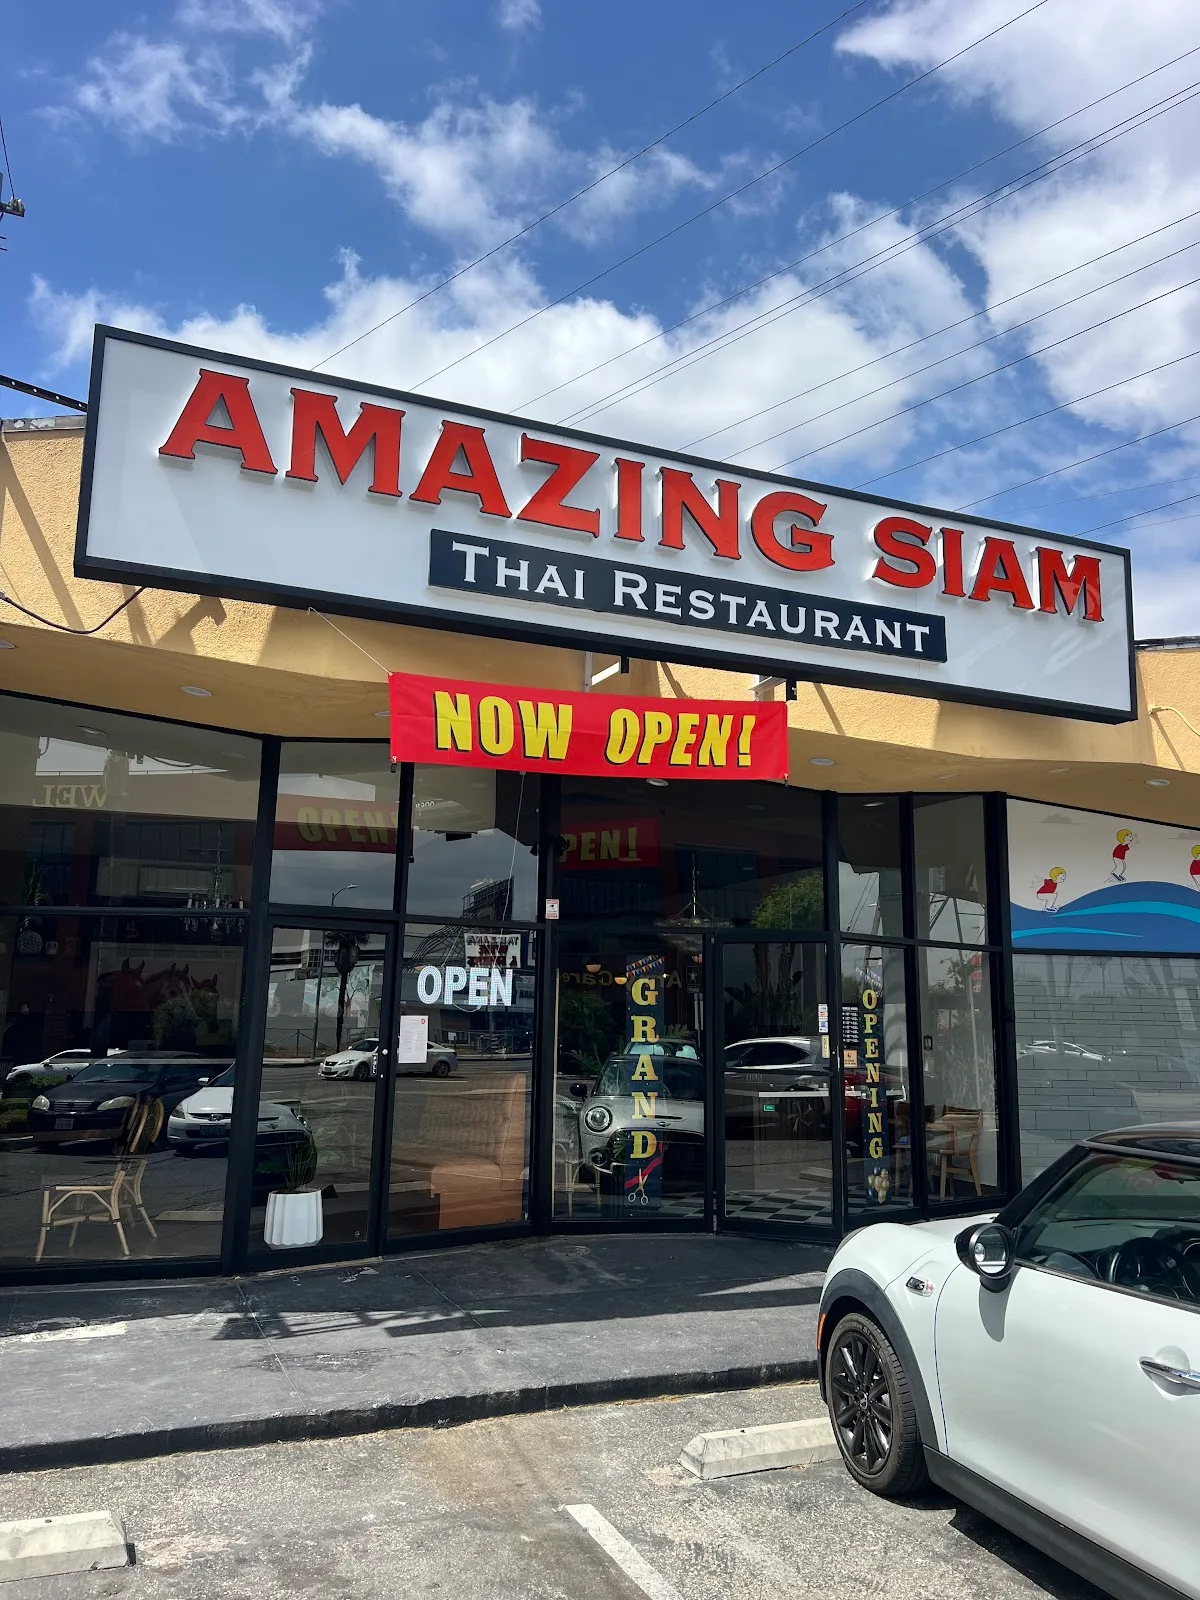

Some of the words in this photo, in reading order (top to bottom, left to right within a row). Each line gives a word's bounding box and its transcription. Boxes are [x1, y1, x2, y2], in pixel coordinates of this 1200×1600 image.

[159, 369, 835, 573] AMAZING
[873, 516, 1104, 622] SIAM
[452, 541, 586, 600] THAI
[613, 569, 930, 653] RESTAURANT
[433, 691, 574, 762] NOW
[605, 708, 756, 768] OPEN!
[417, 965, 513, 1006] OPEN
[630, 978, 659, 1160] GRAND
[862, 989, 884, 1160] OPENING
